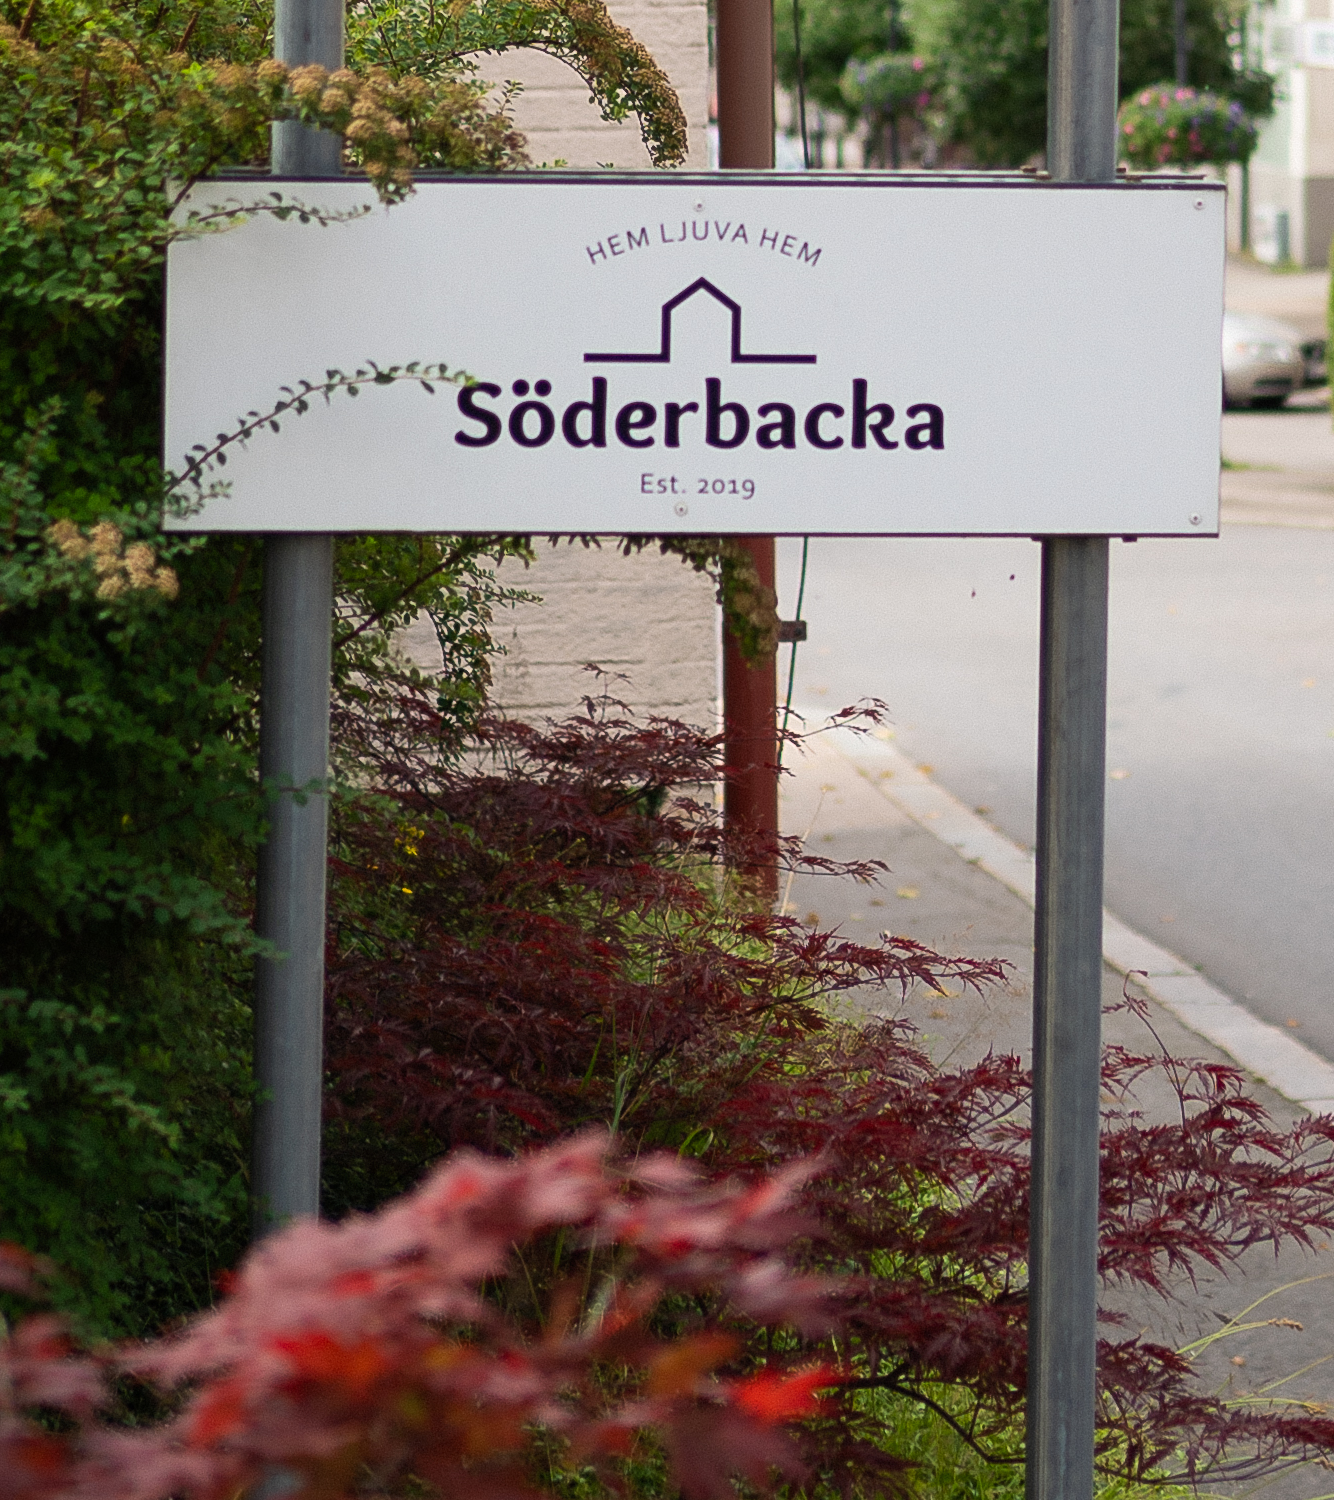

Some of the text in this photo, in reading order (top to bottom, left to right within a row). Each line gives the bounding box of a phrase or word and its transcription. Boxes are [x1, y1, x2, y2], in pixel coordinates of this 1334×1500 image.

[585, 220, 823, 267] HEM LJUVA HEM
[454, 375, 946, 451] Söderbacka
[639, 472, 757, 501] Est. 2019
